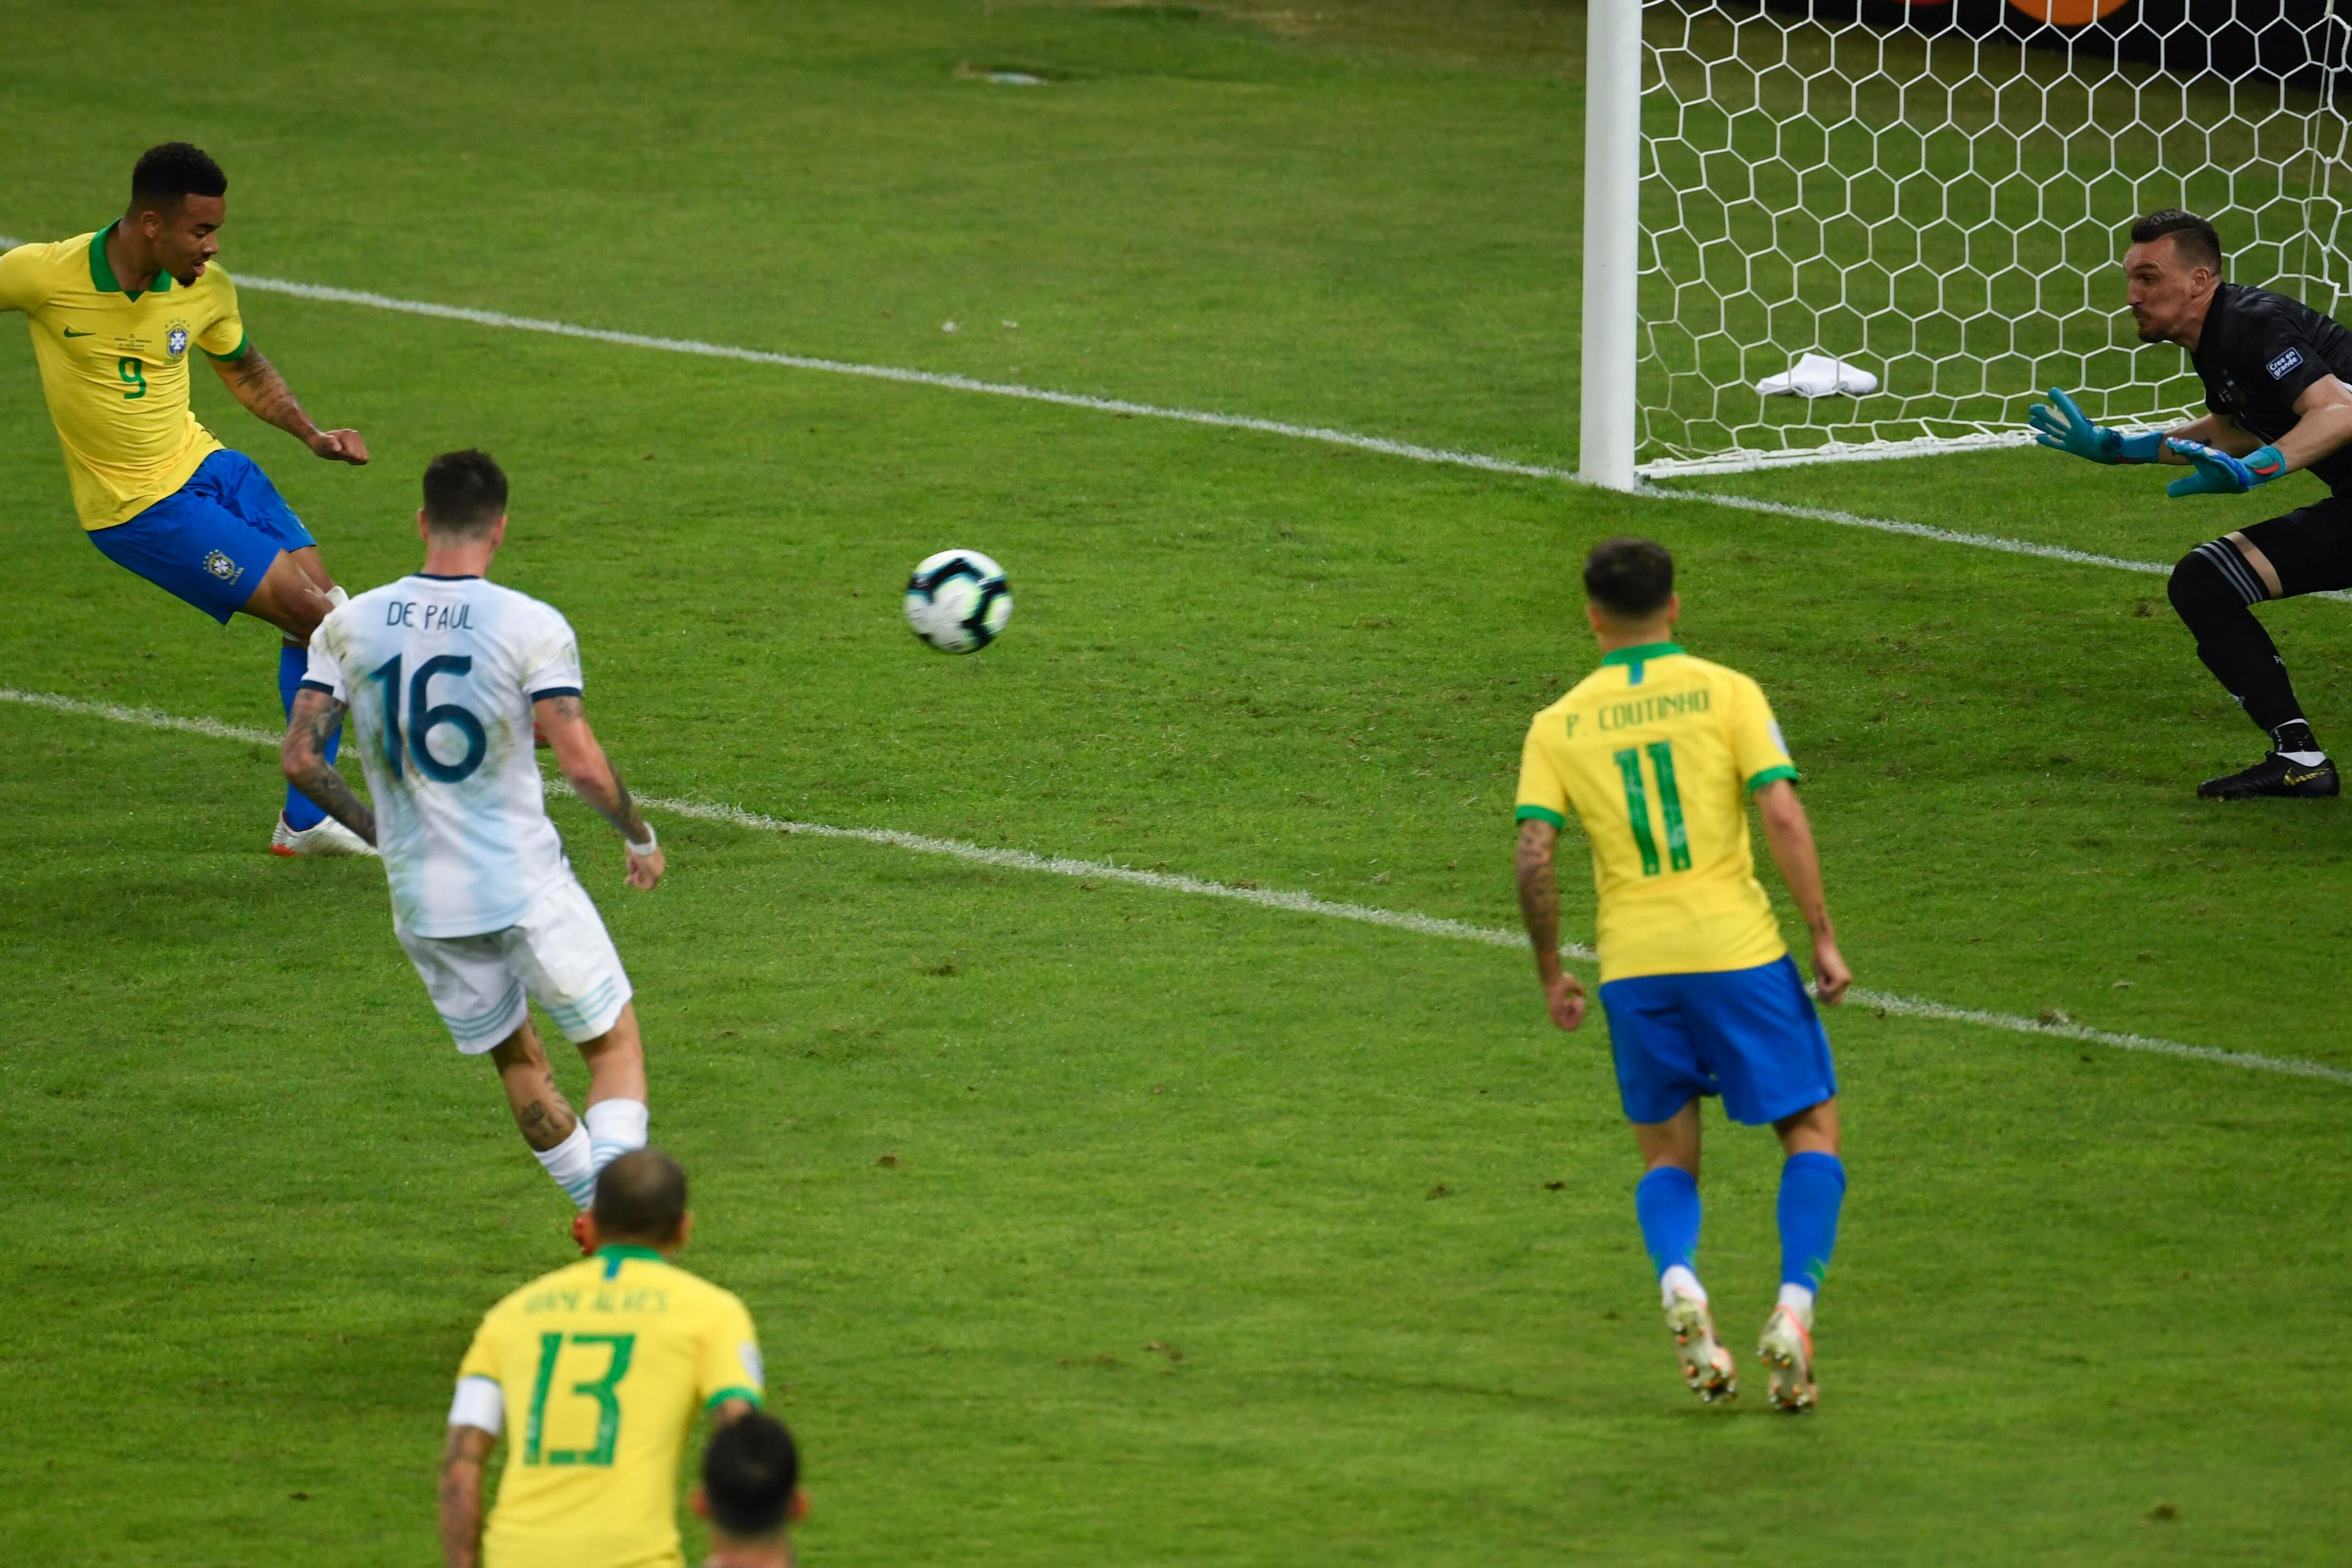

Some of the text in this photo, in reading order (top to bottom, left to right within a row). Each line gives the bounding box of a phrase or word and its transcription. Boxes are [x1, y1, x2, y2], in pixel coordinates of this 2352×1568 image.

[119, 357, 146, 399] 9
[2269, 351, 2296, 371] Cree en
[2274, 357, 2298, 377] grande
[386, 601, 474, 630] DE PAUL
[368, 653, 486, 784] 16
[1598, 689, 1710, 731] COUTINHO
[1613, 740, 1692, 877] 11
[523, 1331, 636, 1466] 13
